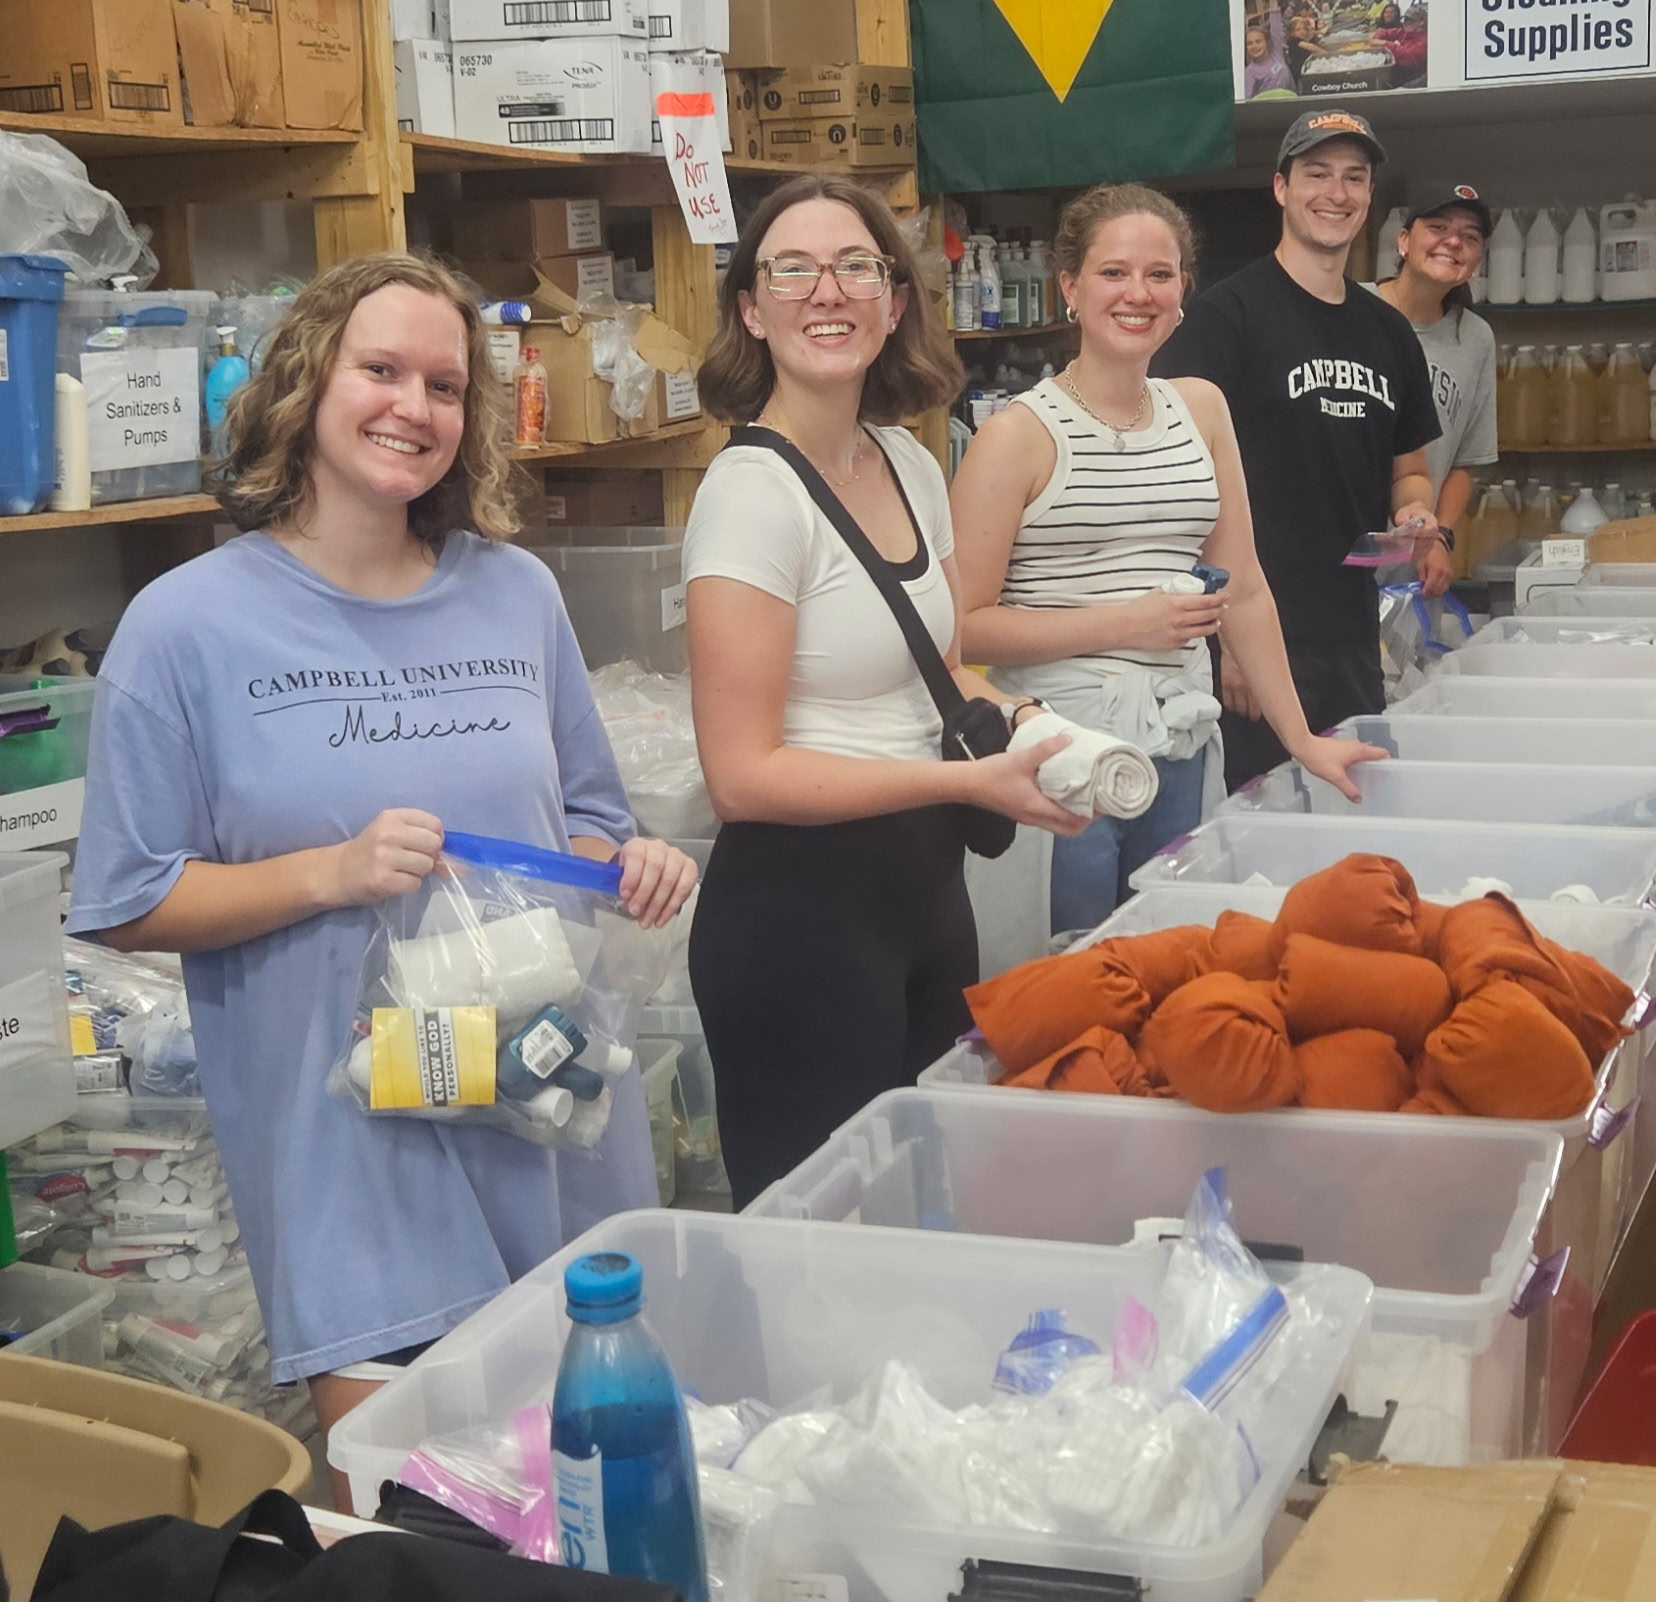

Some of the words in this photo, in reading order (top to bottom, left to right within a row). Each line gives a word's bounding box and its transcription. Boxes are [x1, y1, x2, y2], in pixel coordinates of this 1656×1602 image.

[1484, 13, 1633, 62] Supplies
[459, 54, 493, 67] 065730
[460, 67, 477, 77] V-02
[1311, 82, 1341, 92] Cowboy
[1342, 80, 1369, 90] Church
[675, 132, 695, 160] Do
[684, 161, 710, 188] NOT
[689, 193, 721, 219] USE
[126, 370, 162, 389] Hand
[1287, 358, 1395, 411] CAMPBELL
[105, 400, 170, 420] Sanitizers
[172, 396, 182, 414] &
[124, 429, 168, 447] Pumps
[248, 668, 396, 699] CAMPBELL
[401, 658, 540, 685] UNIVERSITY
[381, 691, 408, 702] Est.
[410, 687, 438, 700] 2011
[329, 703, 511, 748] Medicine
[427, 1020, 440, 1052] GOD
[442, 1023, 456, 1096] PERSONALLY?
[430, 1057, 445, 1101] KNOW
